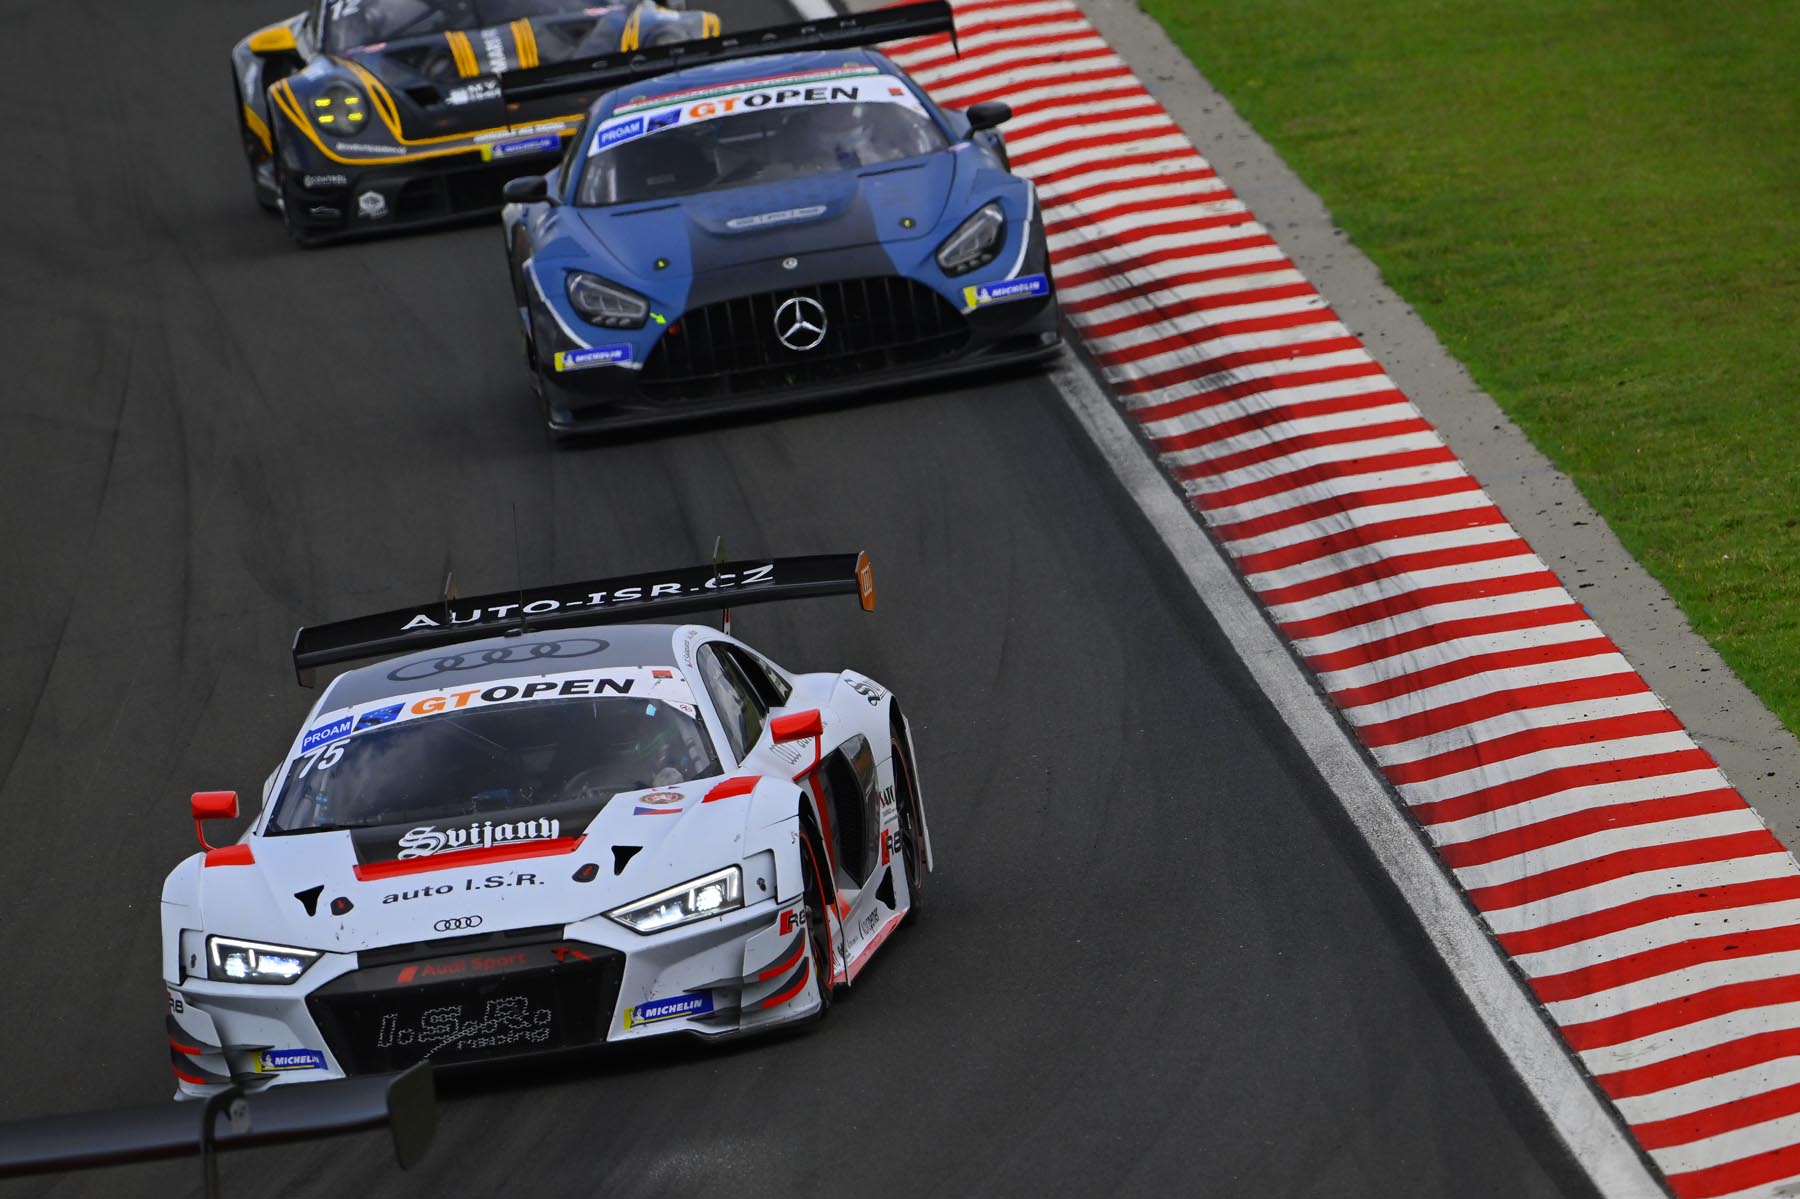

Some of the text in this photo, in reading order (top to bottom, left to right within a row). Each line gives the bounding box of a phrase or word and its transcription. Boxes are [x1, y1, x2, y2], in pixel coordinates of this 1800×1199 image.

[601, 121, 641, 144] PROAM
[991, 281, 1040, 297] MICHELIN
[303, 721, 351, 747] PROAM
[299, 738, 351, 779] 75
[397, 816, 560, 861] Svijany
[382, 873, 545, 905] auto I.S.R.
[421, 953, 527, 977] Audi Sport
[645, 999, 703, 1018] MICHELIN
